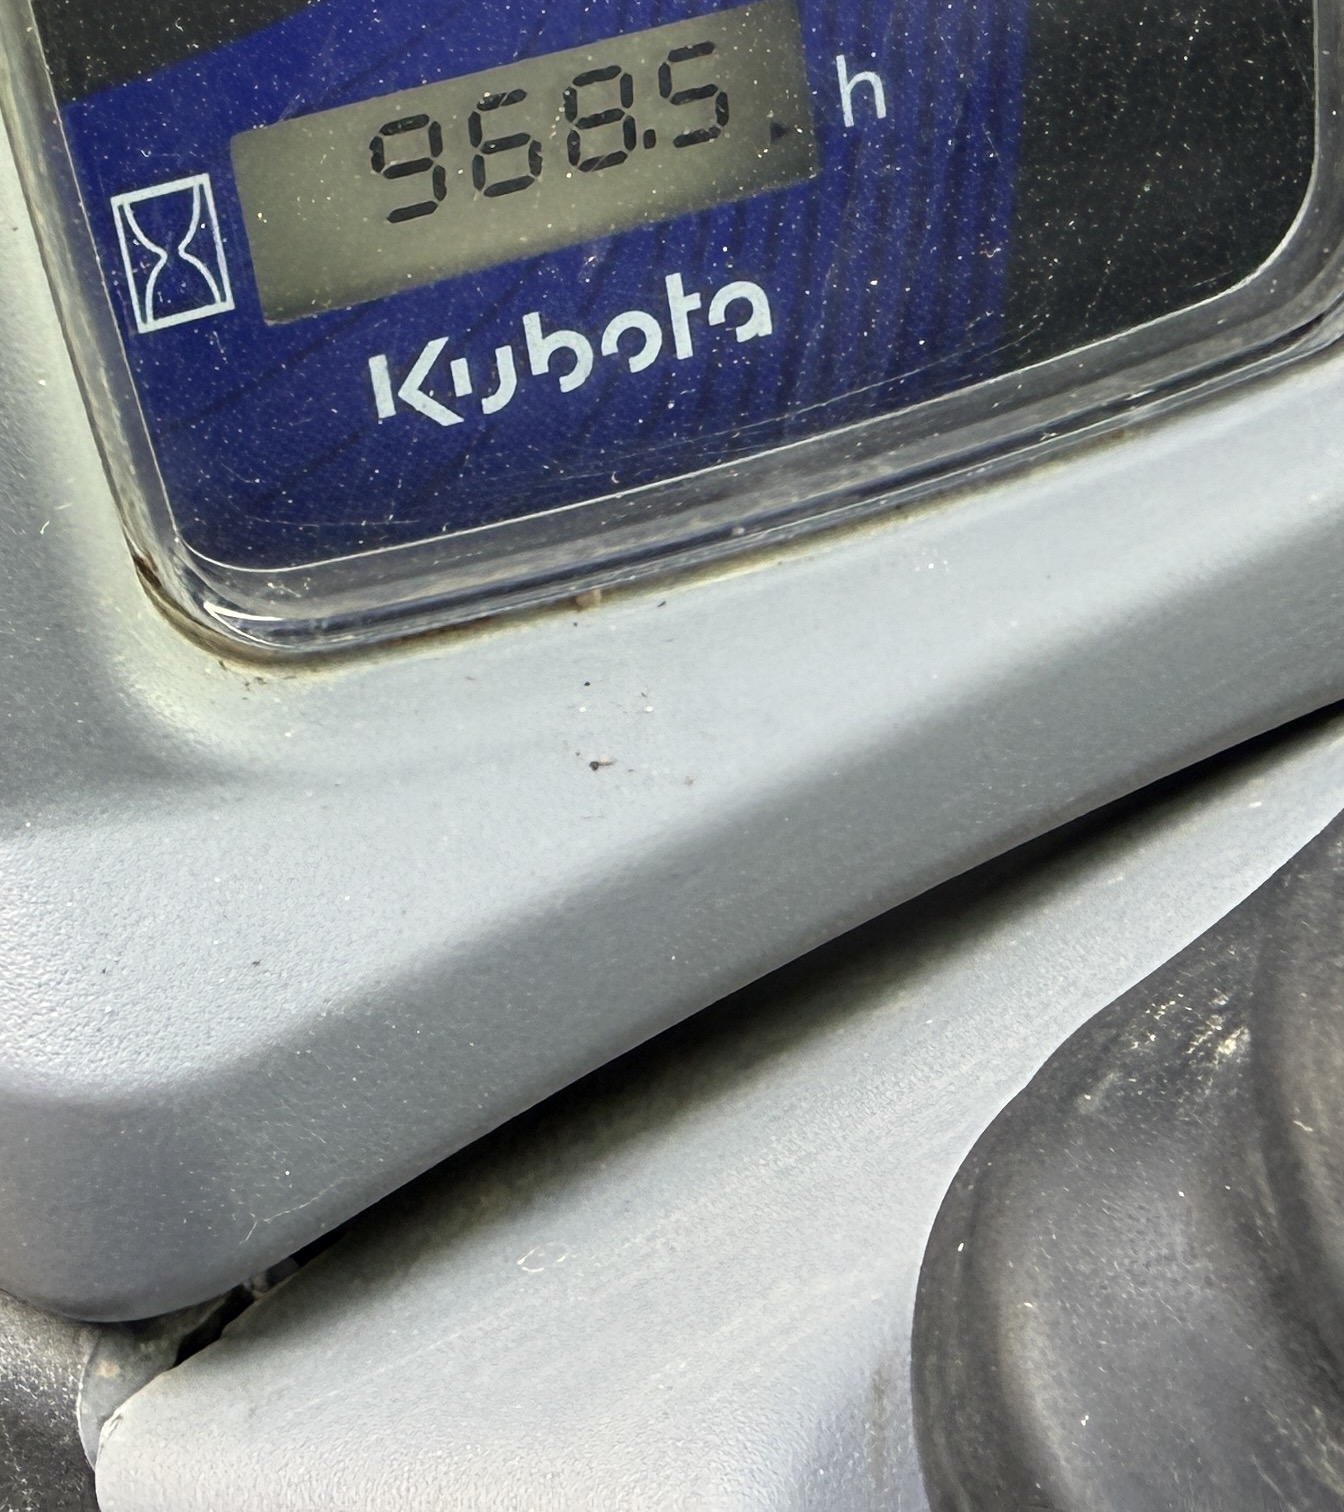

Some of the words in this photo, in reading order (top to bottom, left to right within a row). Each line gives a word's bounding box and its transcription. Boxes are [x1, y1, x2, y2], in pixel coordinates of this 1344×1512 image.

[370, 41, 730, 224] 968.5
[835, 54, 888, 127] h
[368, 272, 774, 427] Kubota
